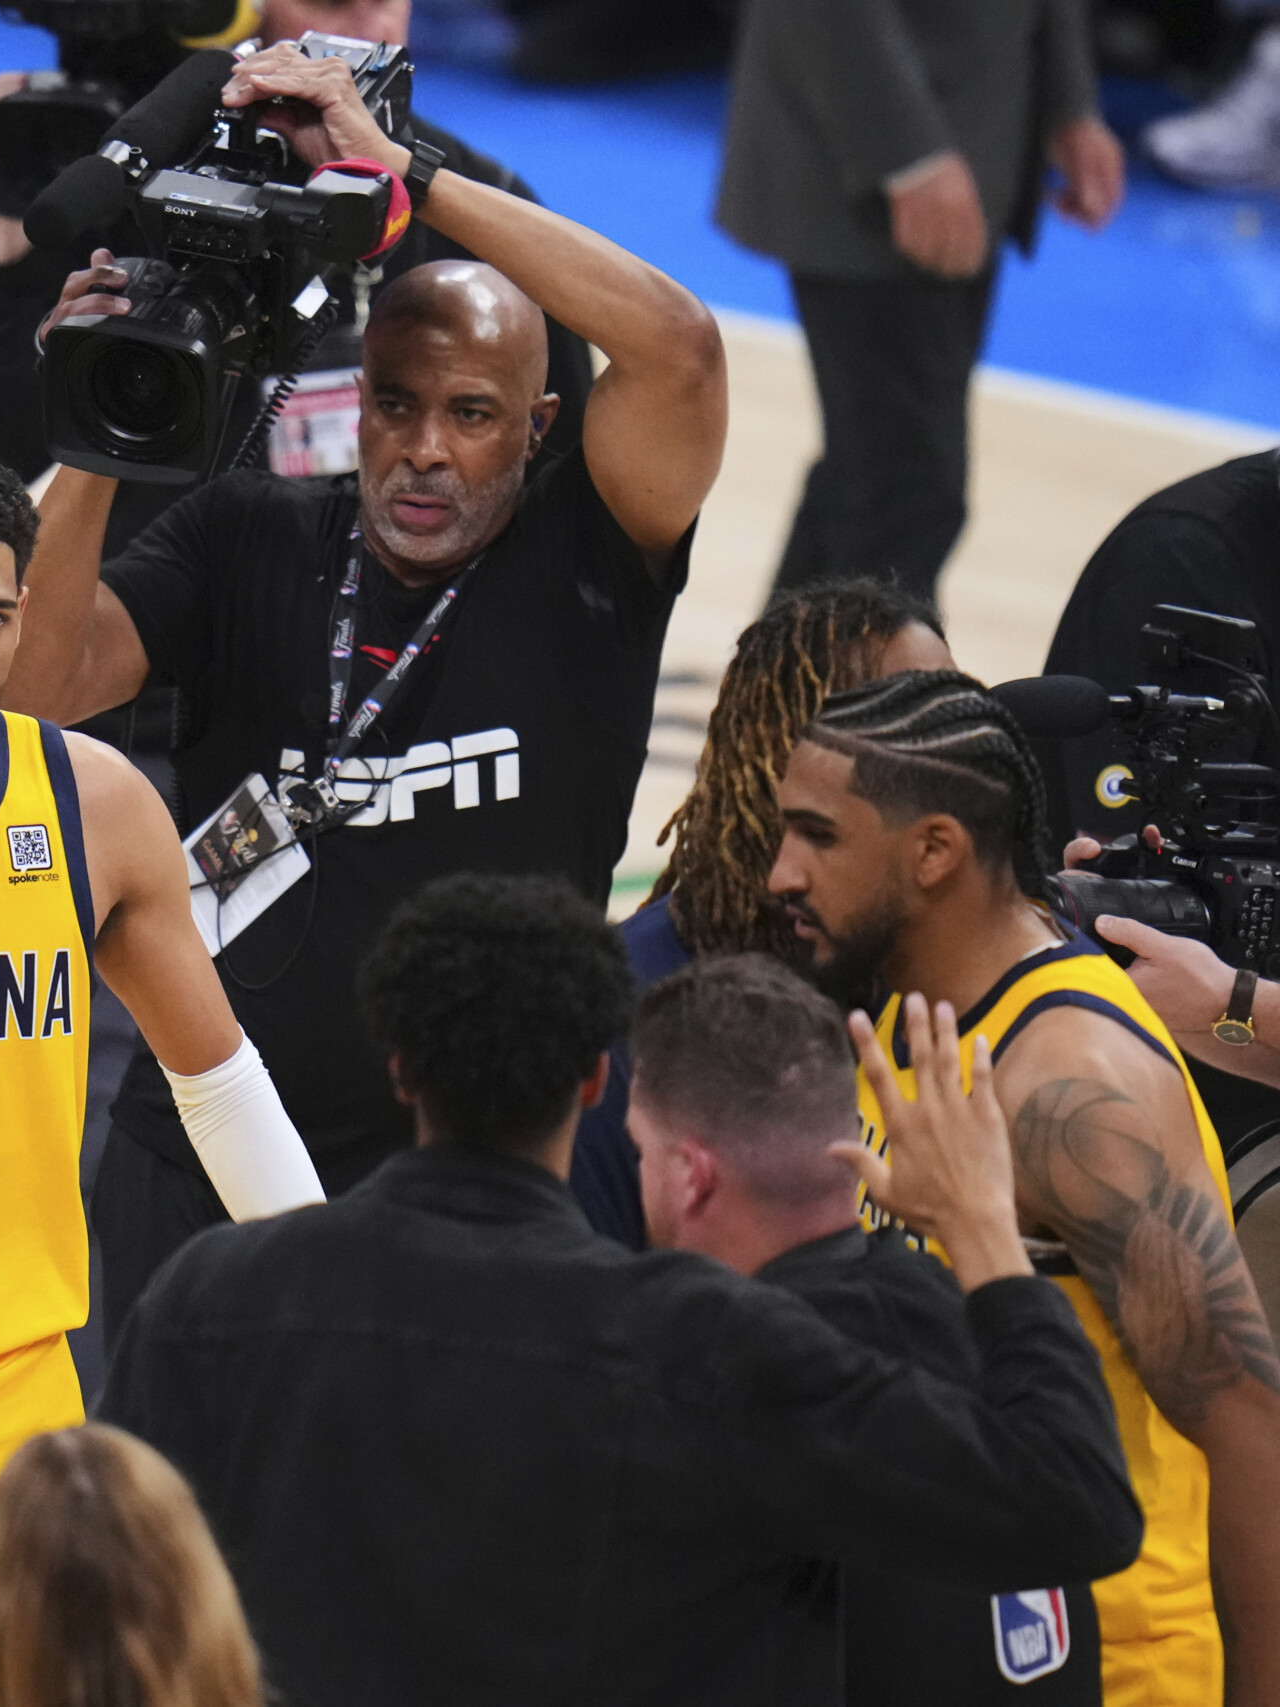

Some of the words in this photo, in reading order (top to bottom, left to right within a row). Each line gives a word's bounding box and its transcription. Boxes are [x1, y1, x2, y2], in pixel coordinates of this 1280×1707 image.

[164, 205, 197, 217] SONY
[333, 617, 353, 653] Finals
[386, 651, 414, 681] Finals
[347, 702, 377, 739] Finals
[1172, 856, 1197, 869] Canon
[8, 872, 60, 887] spokenote
